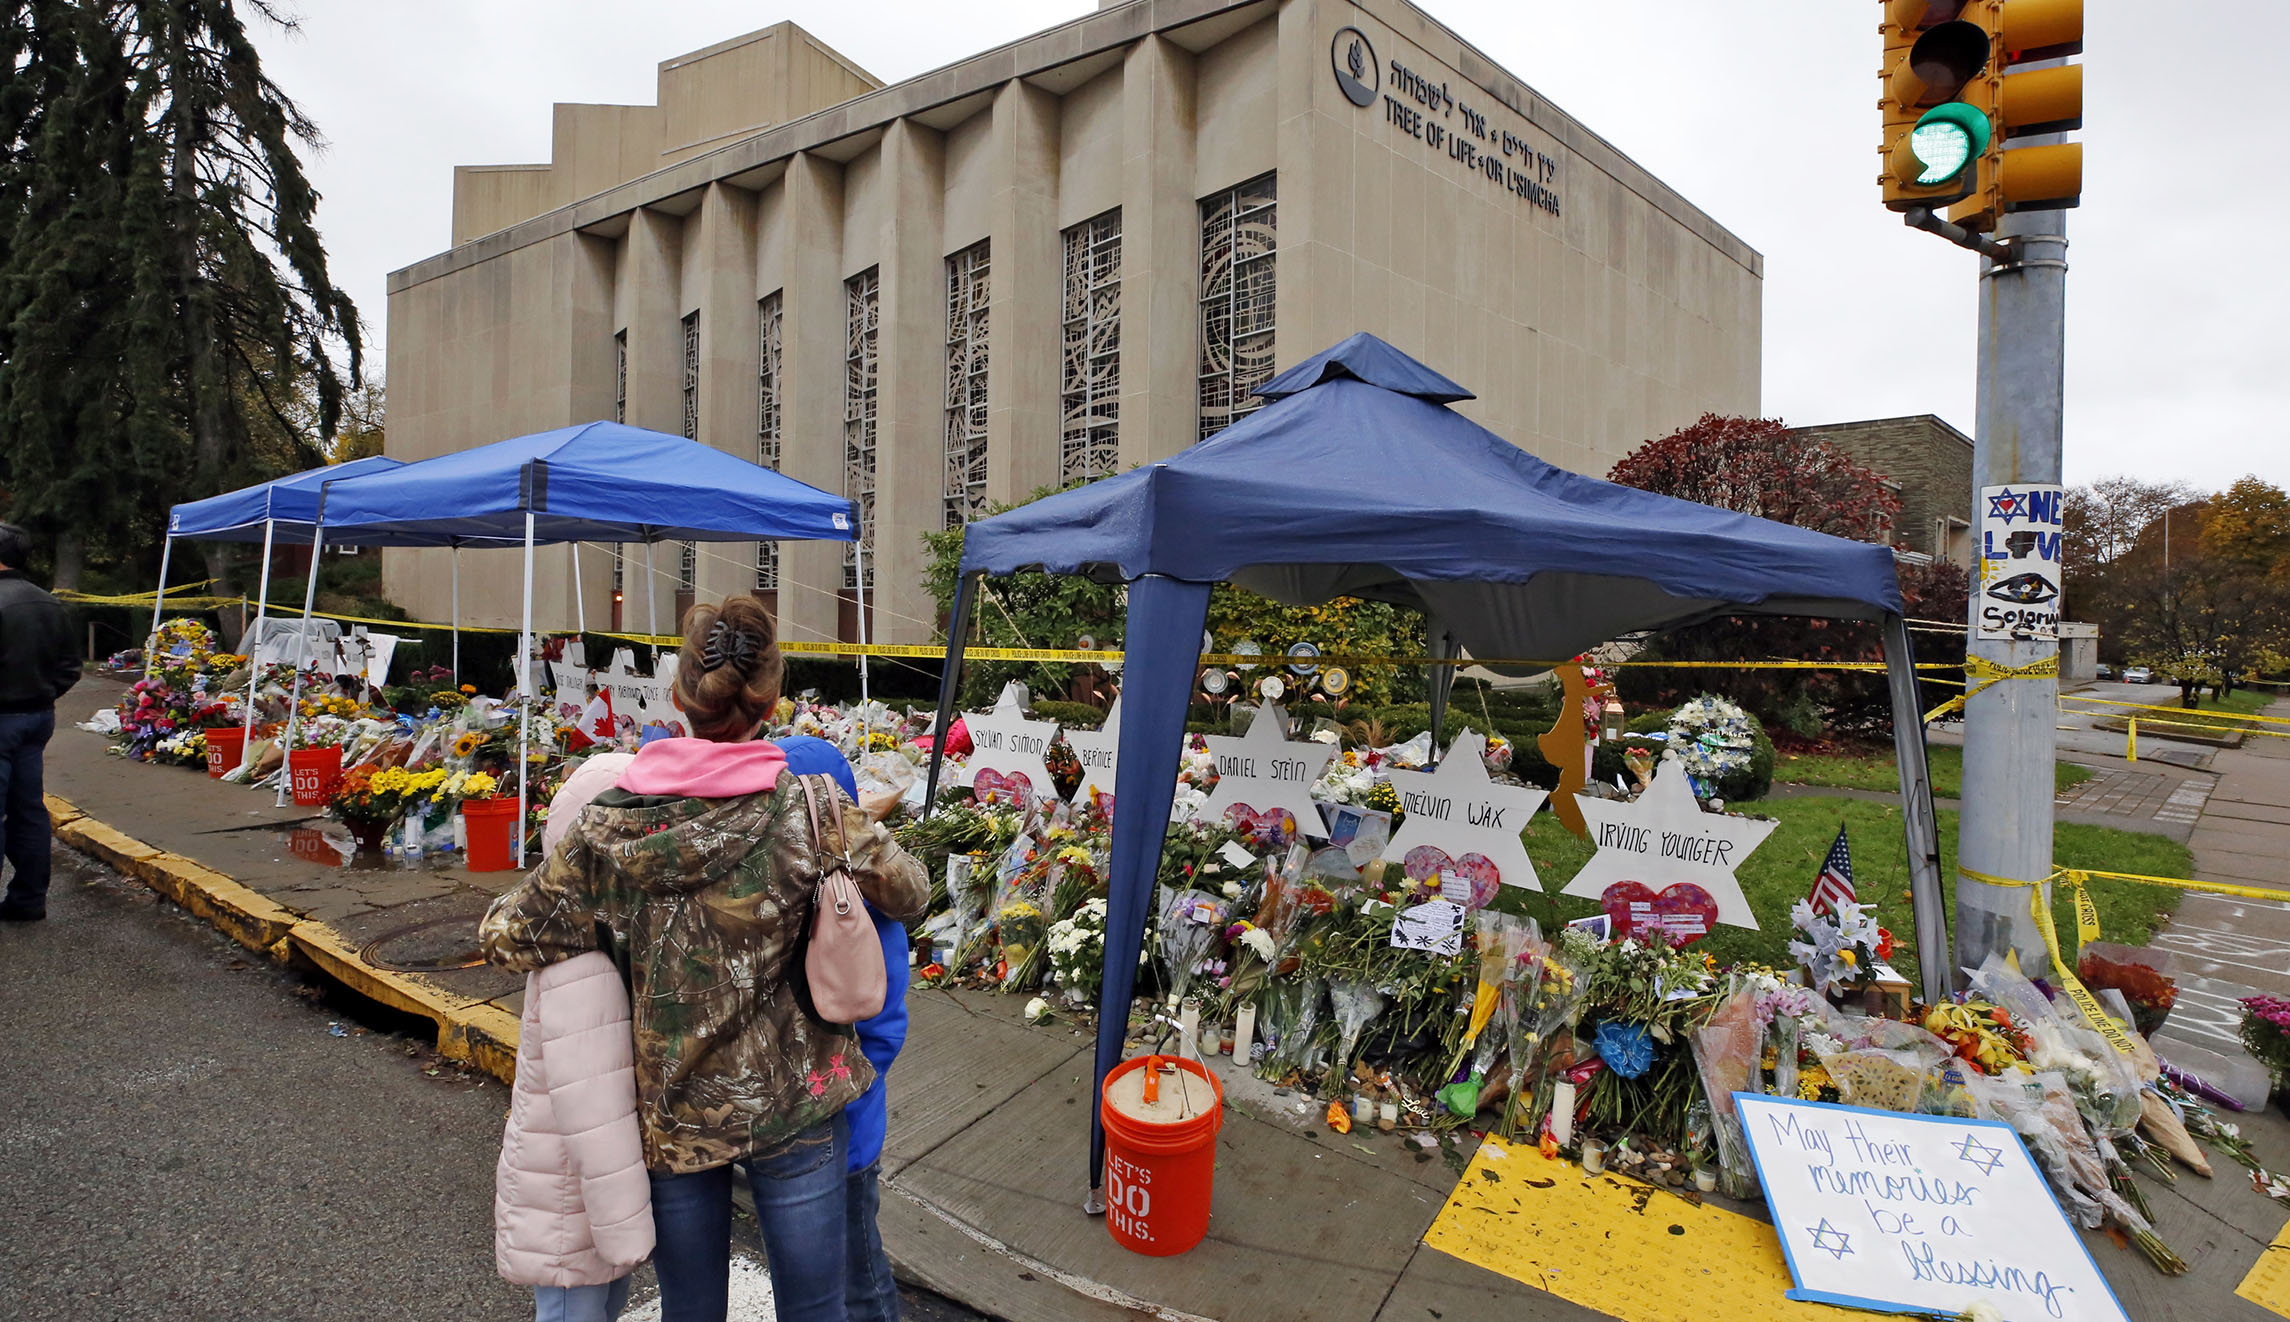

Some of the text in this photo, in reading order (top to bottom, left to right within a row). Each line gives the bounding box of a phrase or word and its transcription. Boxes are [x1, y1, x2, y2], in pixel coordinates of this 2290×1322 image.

[1391, 59, 1454, 118] לשמחה
[1384, 94, 1560, 217] TREE OF LIFE OR L'SIMCHA
[975, 729, 1043, 756] SYLVAN SIMON
[1083, 747, 1112, 769] BERNICE
[294, 768, 319, 776] LET'S
[295, 776, 319, 790] DO
[1219, 755, 1306, 782] DANIEL STEIN
[1402, 790, 1506, 828] MELVIN WAX
[1599, 822, 1734, 866] IRVING YOUNGER
[2070, 988, 2135, 1051] POLICE LINE DO NOT
[1401, 1094, 1430, 1119] Love
[1768, 1112, 1913, 1167] May their
[1108, 1146, 1151, 1185] LET'S
[1808, 1163, 1979, 1206] memories
[1108, 1167, 1150, 1218] DO
[1108, 1199, 1155, 1242] THIS.
[1864, 1199, 1974, 1238] be a
[1902, 1240, 2075, 1320] blessing.
